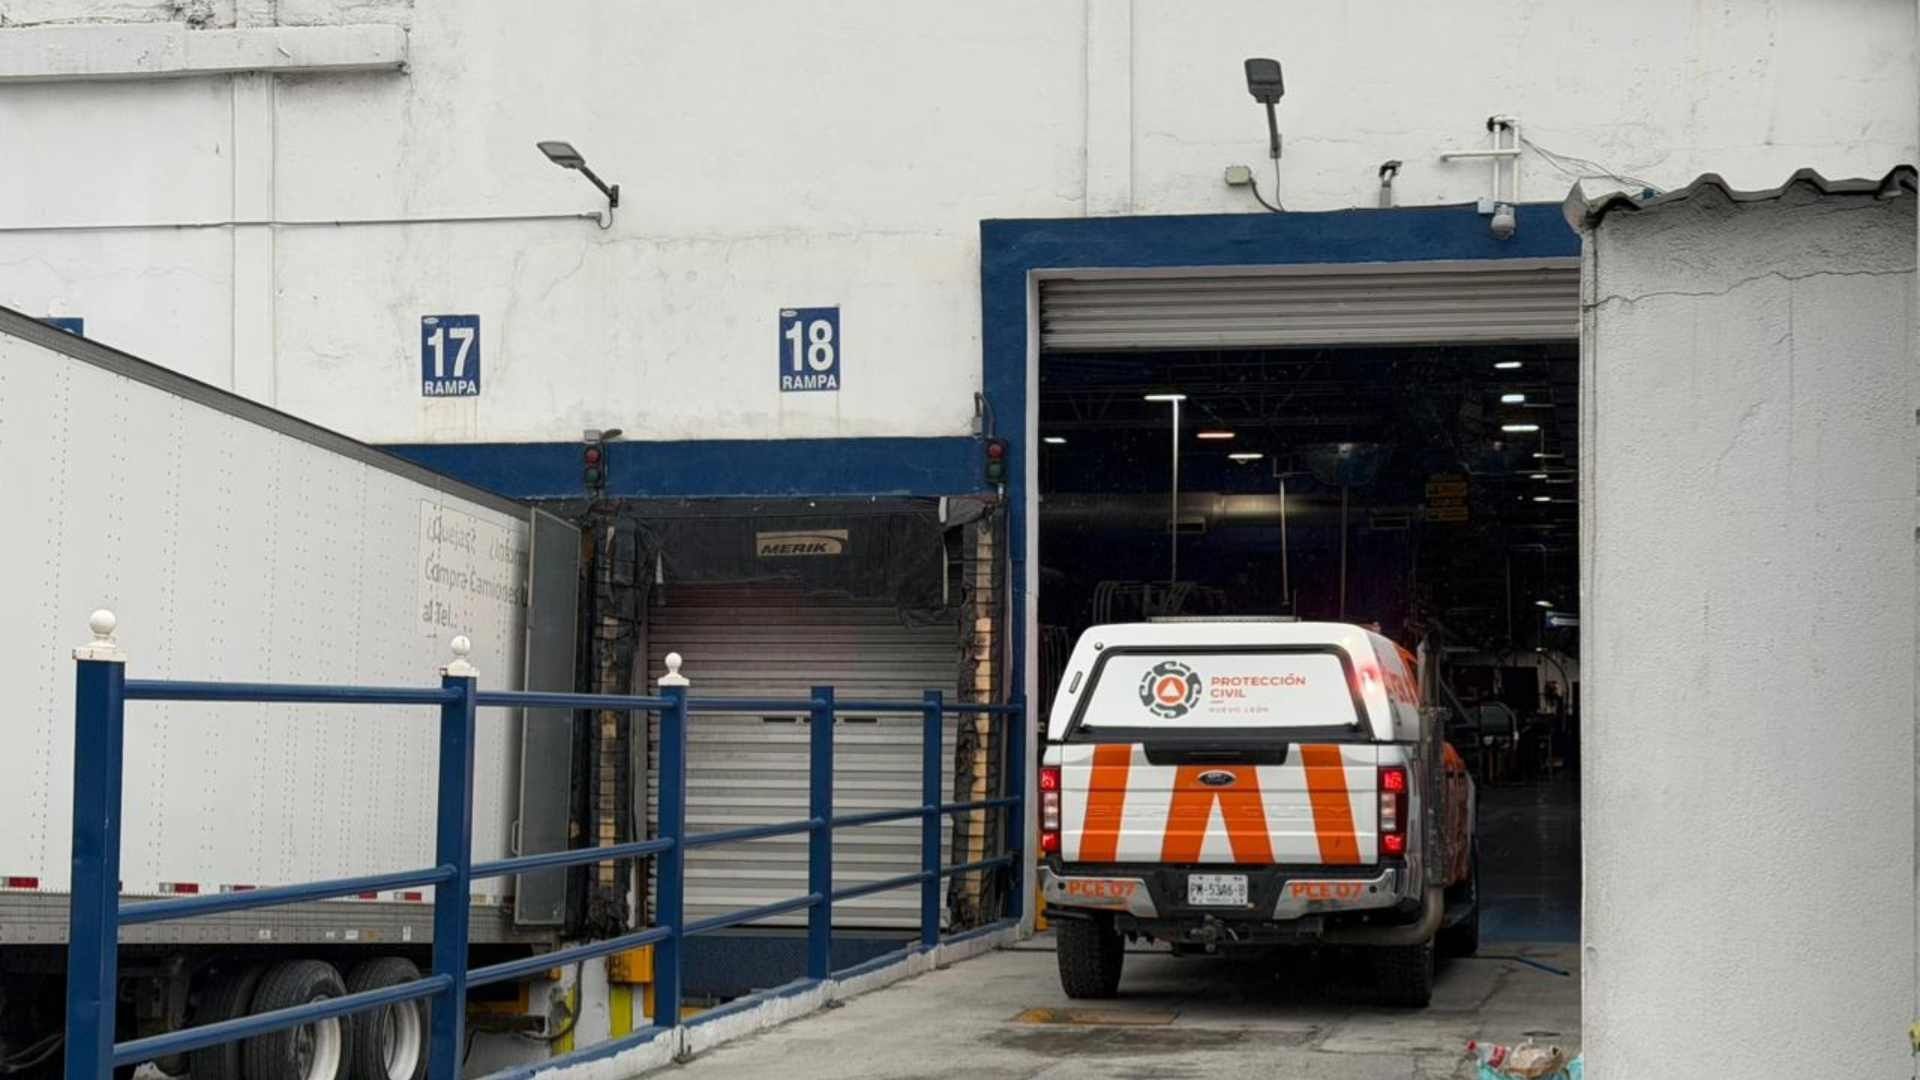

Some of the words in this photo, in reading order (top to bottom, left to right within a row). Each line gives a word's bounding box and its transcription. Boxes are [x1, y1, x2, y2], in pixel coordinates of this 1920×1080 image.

[427, 328, 474, 377] 17
[785, 319, 835, 371] 18
[424, 380, 477, 395] RAMPA
[782, 374, 837, 390] RAMPA
[761, 542, 827, 554] MERIK
[424, 555, 468, 591] Compra
[1210, 672, 1306, 686] PROTECCIÓN
[1210, 688, 1246, 698] CIVIL
[1068, 880, 1104, 898] PCE
[1111, 880, 1137, 898] 07
[1292, 882, 1329, 900] PCE
[1336, 882, 1363, 899] 07
